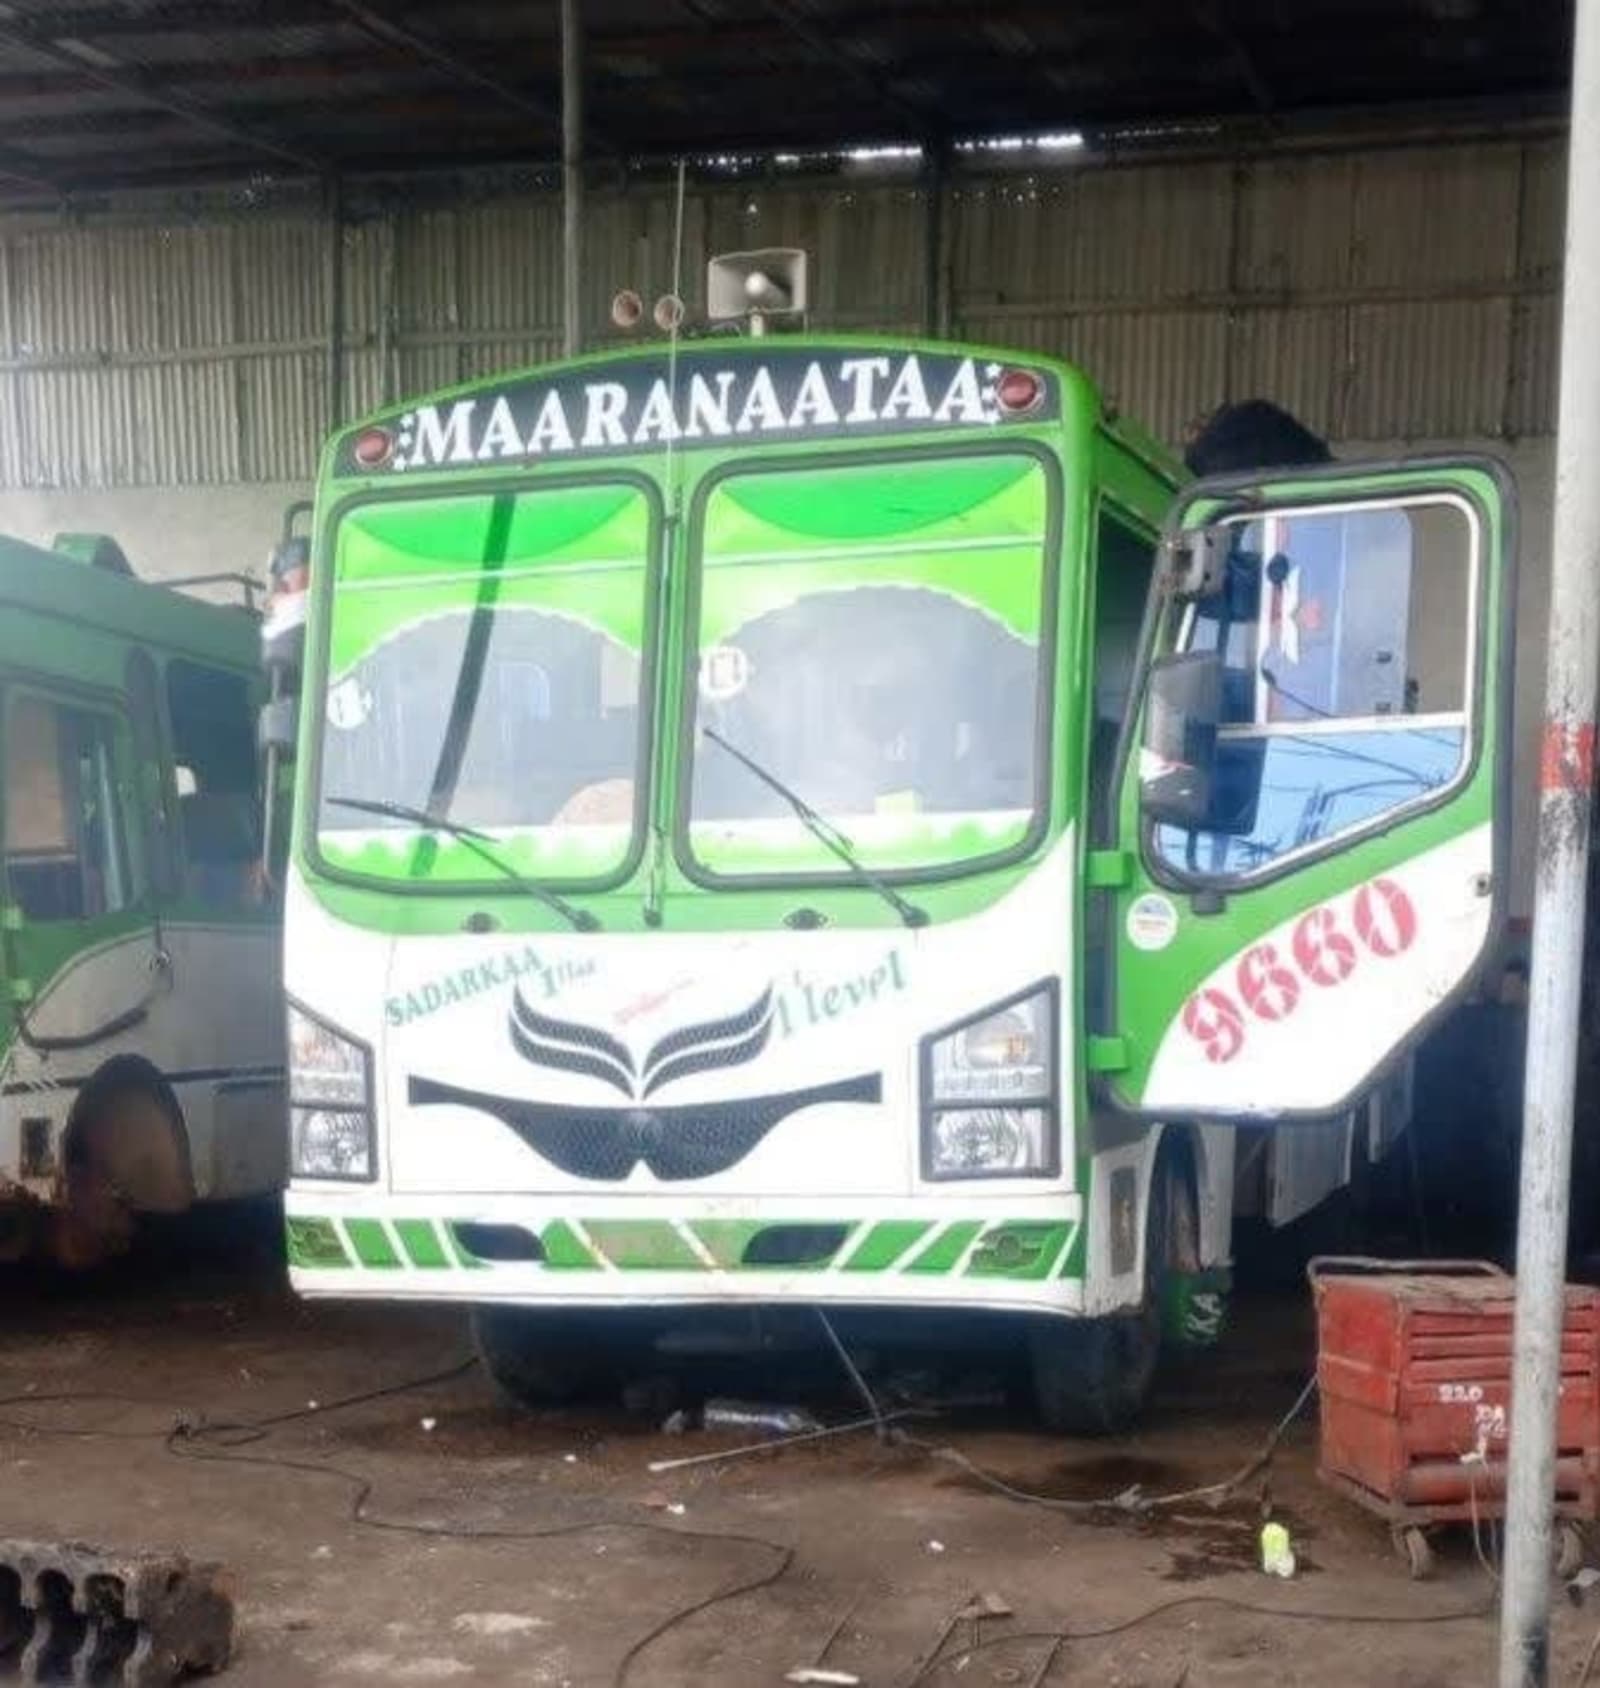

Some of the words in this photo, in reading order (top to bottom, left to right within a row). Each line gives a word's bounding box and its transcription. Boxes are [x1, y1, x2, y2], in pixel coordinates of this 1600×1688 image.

[410, 354, 985, 467] MAARANAATAA
[385, 945, 543, 1027] SADARKAA
[1183, 878, 1417, 1064] 9660
